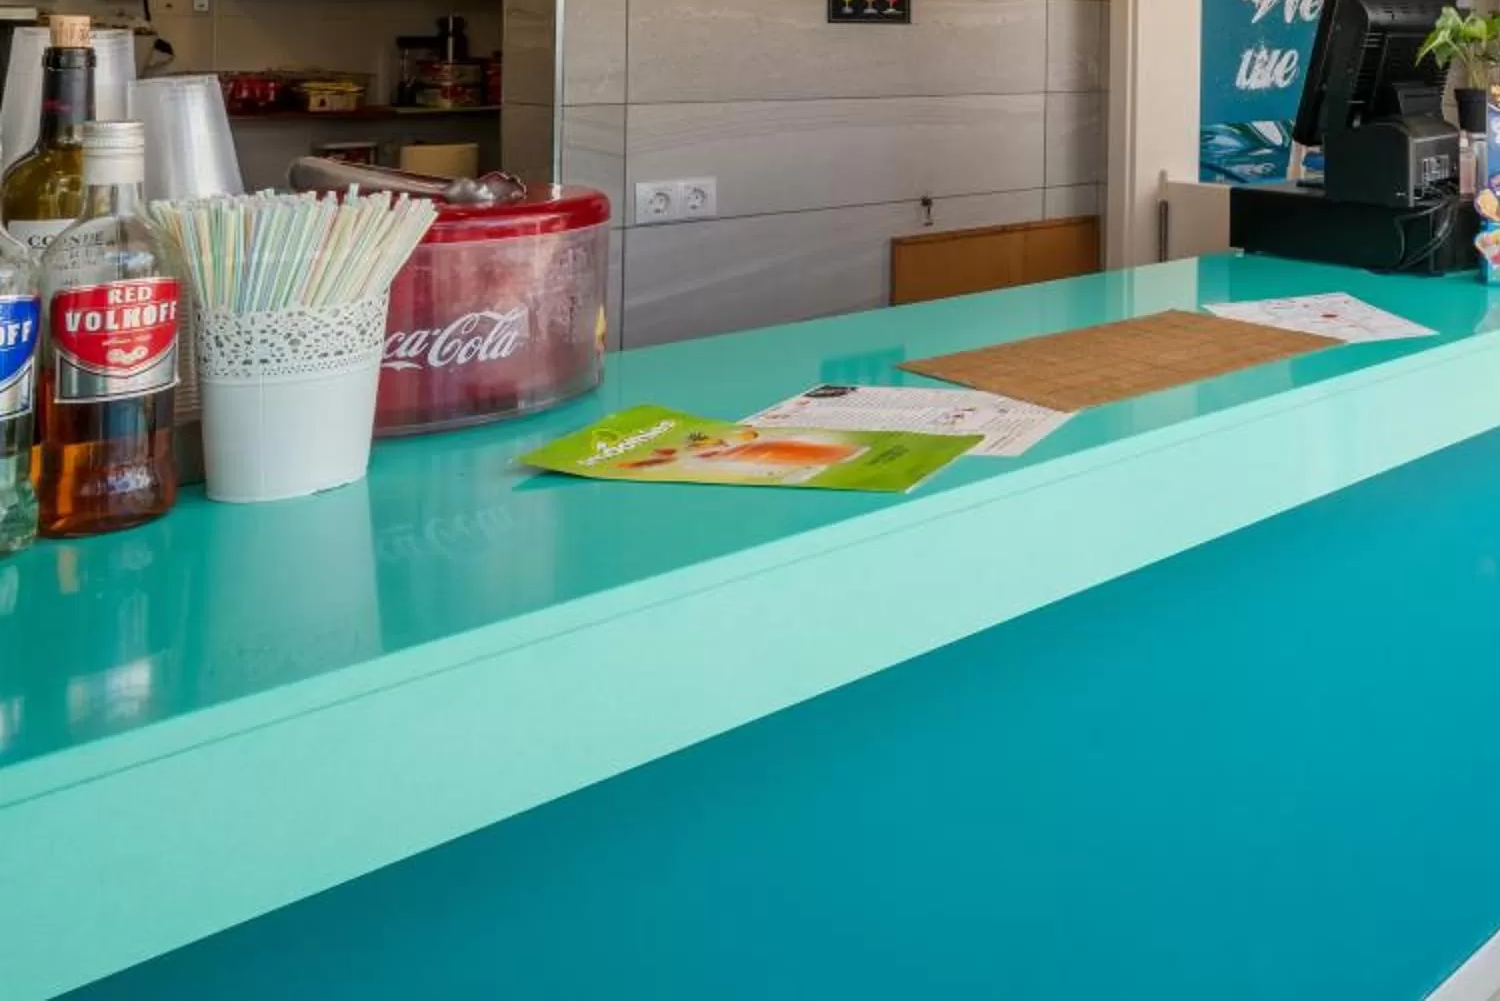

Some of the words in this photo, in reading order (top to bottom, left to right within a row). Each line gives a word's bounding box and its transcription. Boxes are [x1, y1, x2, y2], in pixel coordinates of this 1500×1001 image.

[107, 285, 153, 305] RED
[64, 299, 178, 333] VOLKOFF
[381, 303, 530, 370] ca-Cola
